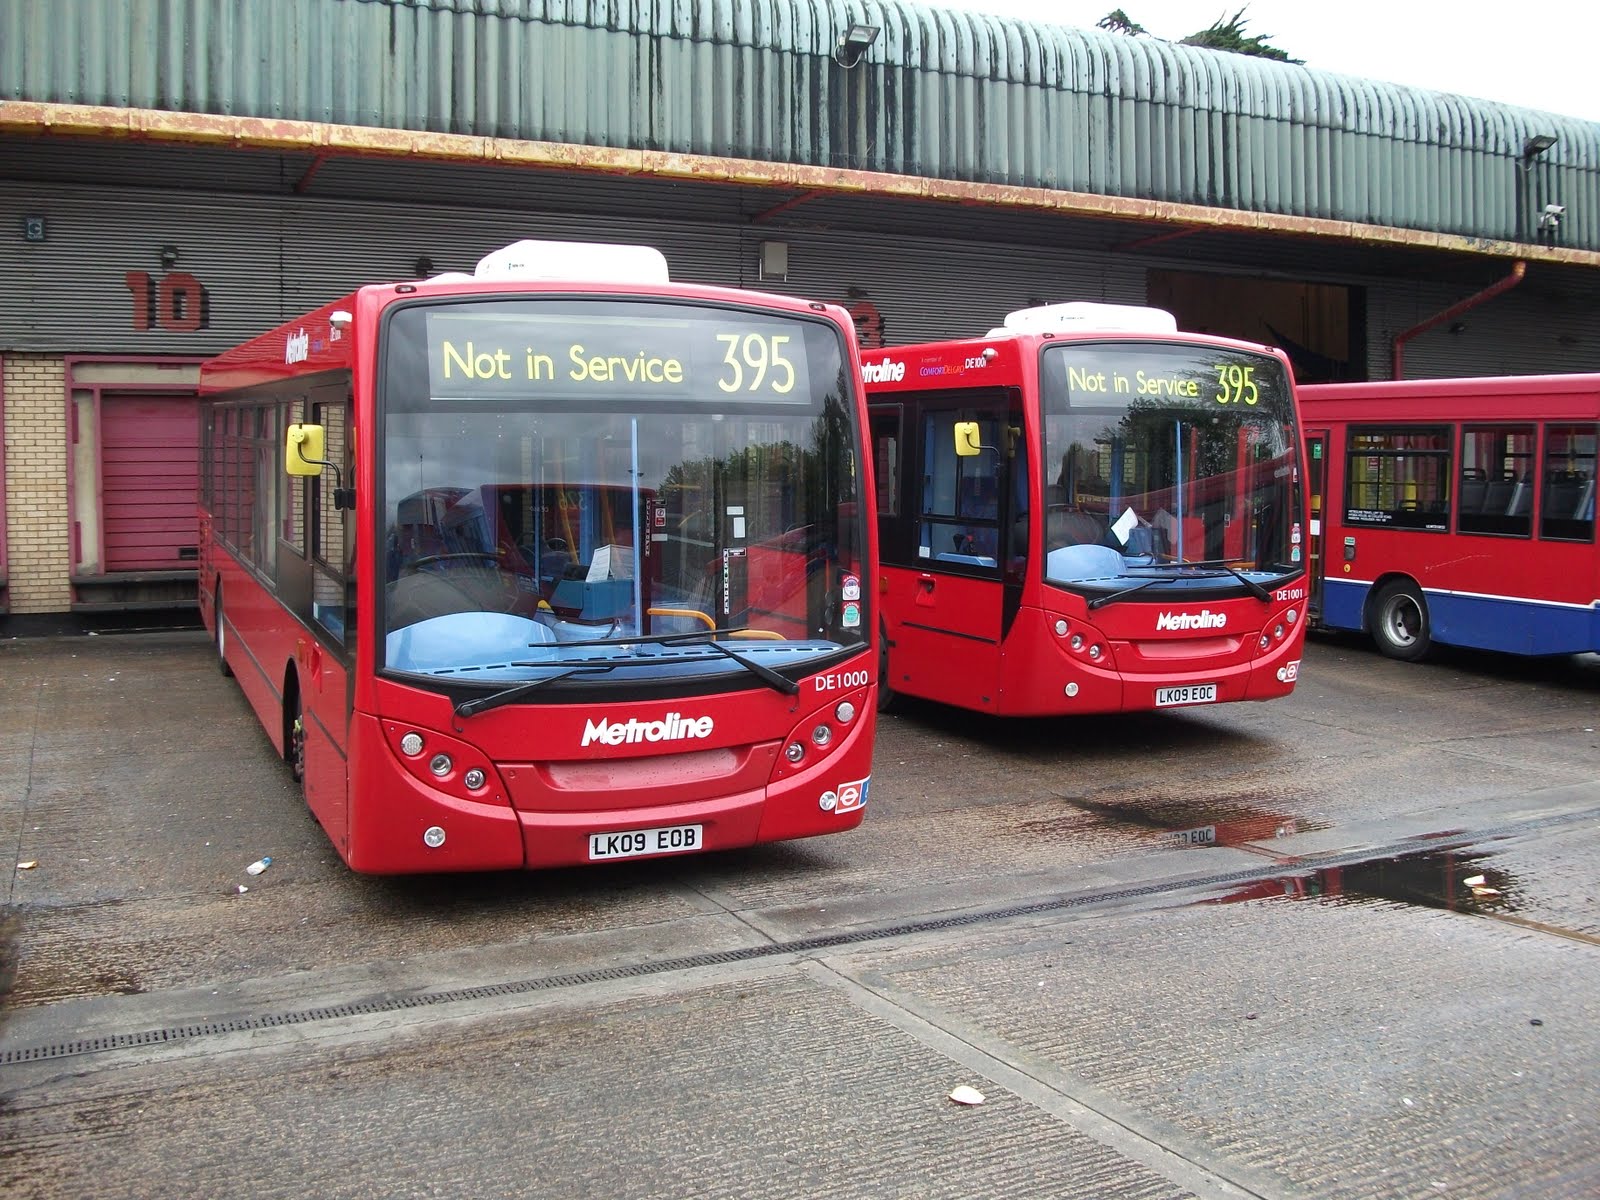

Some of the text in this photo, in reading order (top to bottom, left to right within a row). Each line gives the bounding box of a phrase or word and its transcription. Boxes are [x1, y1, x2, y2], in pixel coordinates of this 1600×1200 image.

[125, 270, 208, 332] 10
[443, 341, 683, 384] Not in Service
[716, 333, 796, 394] 395
[862, 357, 905, 383] troline
[1069, 368, 1199, 397] Not in Service
[1214, 364, 1259, 405] 395
[1276, 588, 1303, 601] DE1001
[1156, 609, 1226, 631] Metroline
[815, 670, 869, 692] DE1000
[1159, 686, 1213, 703] LK09 EOC
[581, 713, 714, 747] Metroline
[595, 827, 696, 855] LK09 EOB
